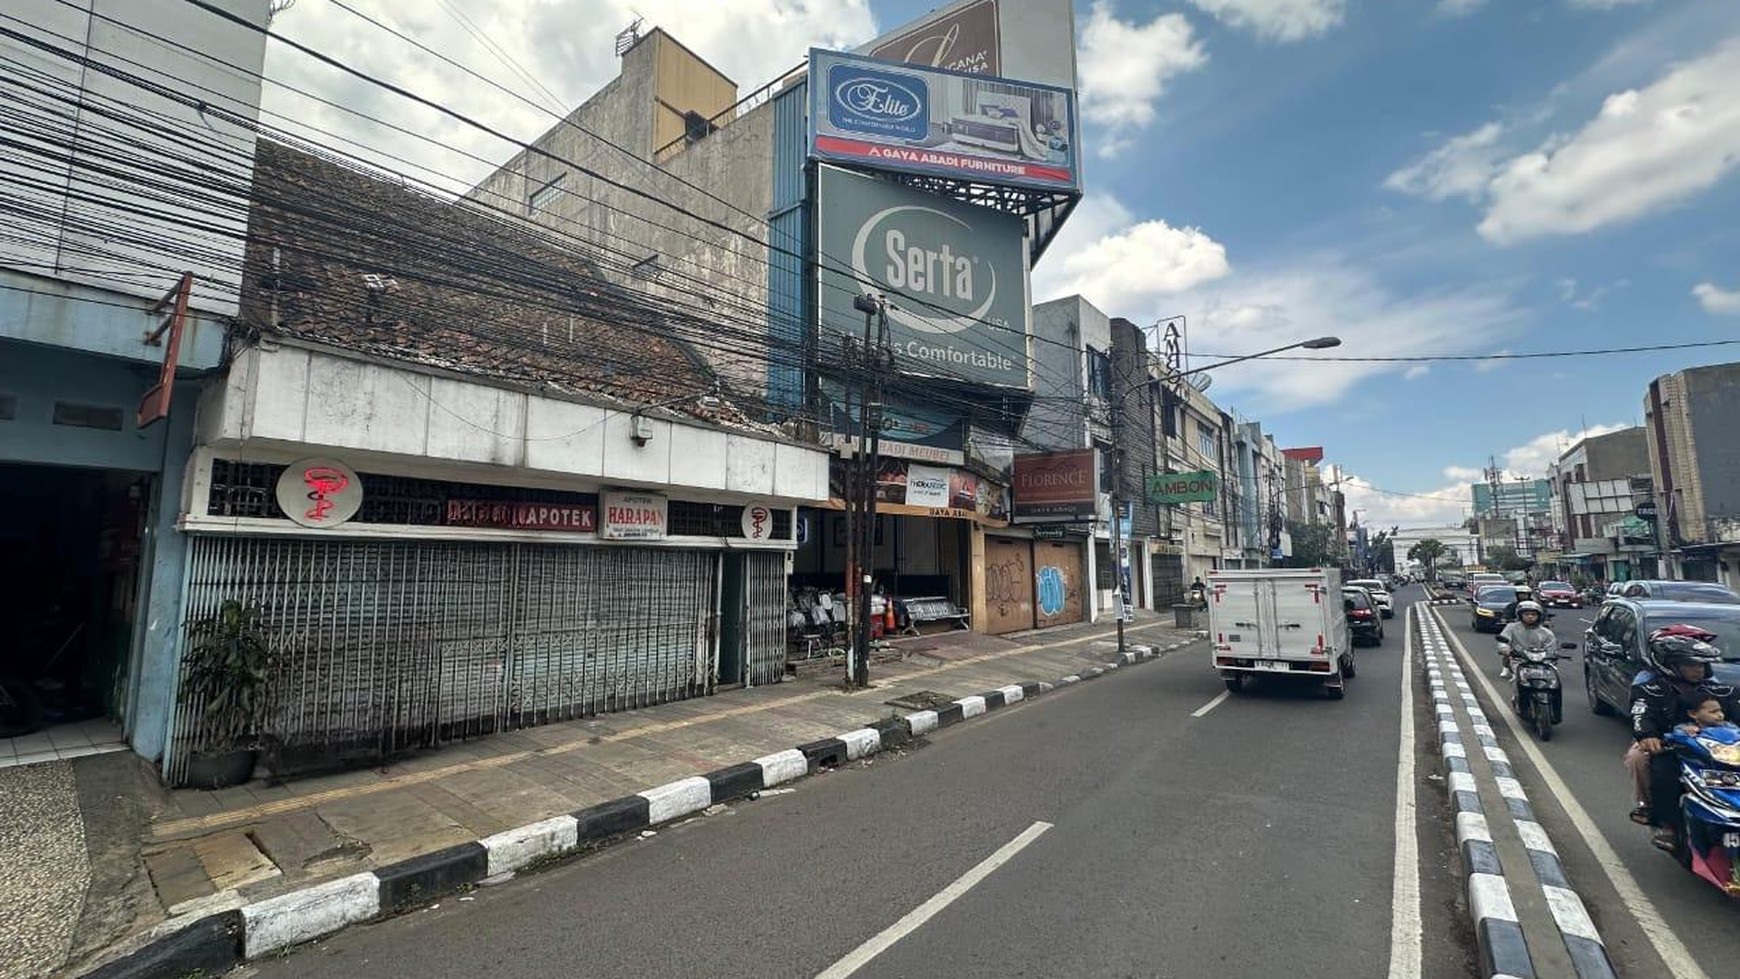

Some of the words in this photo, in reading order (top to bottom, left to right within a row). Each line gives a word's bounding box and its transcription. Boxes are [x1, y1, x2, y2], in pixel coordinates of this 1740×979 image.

[847, 83, 909, 117] Elite
[883, 149, 918, 162] GAYA
[920, 154, 959, 167] ABADI
[960, 159, 1026, 175] FURNITURE
[885, 228, 974, 302] Serta
[986, 316, 1012, 334] USA
[906, 340, 1014, 371] Comfortable
[1152, 479, 1213, 496] AMBON
[526, 506, 592, 527] APOTEK
